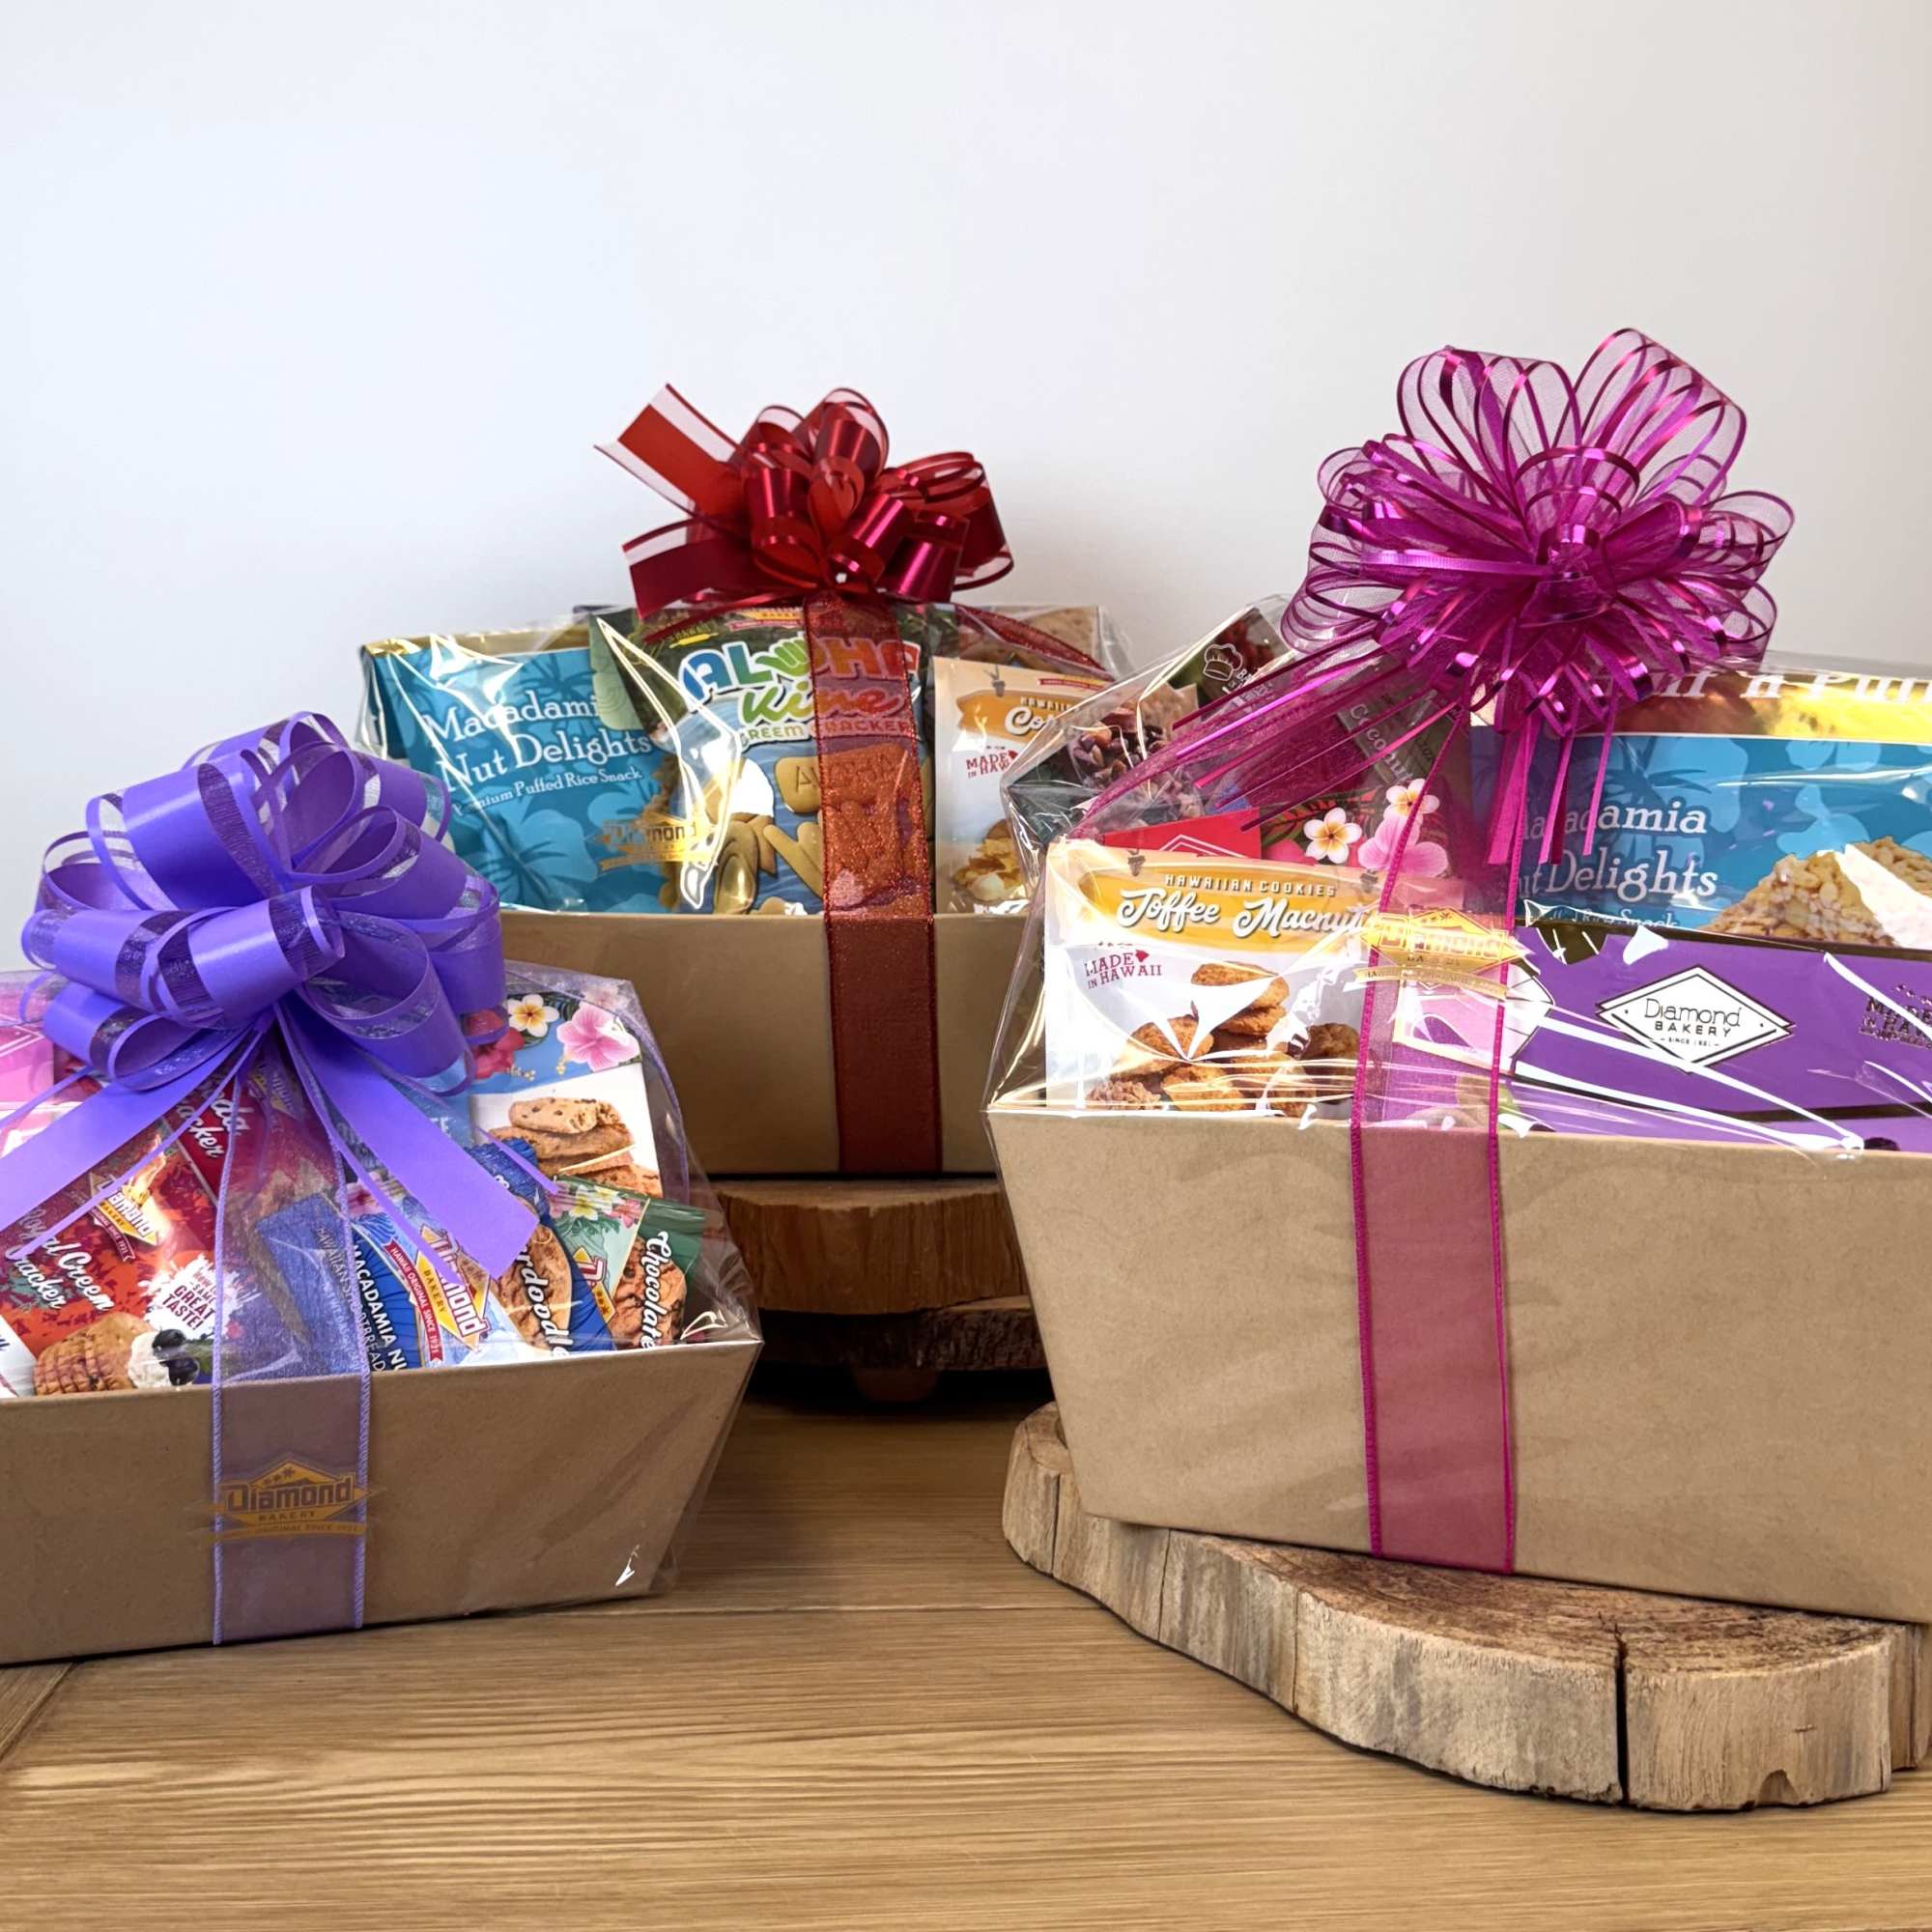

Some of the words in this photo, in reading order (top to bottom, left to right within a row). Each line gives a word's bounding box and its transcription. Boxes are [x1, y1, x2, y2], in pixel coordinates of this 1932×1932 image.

[423, 690, 598, 748] Macadami
[1020, 696, 1078, 713] HAWAII
[437, 749, 508, 793] Nut
[509, 728, 653, 770] Delights
[966, 752, 1007, 771] MADE
[980, 758, 1010, 776] HAW
[514, 780, 565, 799] Puffed
[566, 772, 598, 789] Rice
[600, 766, 643, 783] Snack
[1165, 873, 1254, 893] HAWAIIAN
[1259, 880, 1338, 897] COOKIES
[1546, 846, 1719, 902] Delights
[1116, 887, 1222, 933] Toffee
[1084, 952, 1135, 978] MADE
[1087, 978, 1098, 990] IN
[1100, 964, 1163, 985] HAWAII
[1643, 997, 1743, 1028] Diamond
[1655, 1020, 1732, 1037] BAKERY
[1668, 1037, 1690, 1045] SINCE
[58, 1251, 115, 1311] Creem
[423, 1268, 447, 1313] BAKERY
[639, 1230, 672, 1349] Chocolate
[162, 1293, 205, 1331] TASTE!
[173, 1285, 217, 1321] GREAT
[353, 1245, 397, 1349] MACADAMIA
[387, 1348, 408, 1371] NU
[389, 1246, 411, 1273] HAWAII
[408, 1271, 429, 1309] ORIGINAL
[422, 1308, 435, 1332] SINCE
[429, 1333, 440, 1354] 1921
[220, 1476, 354, 1512] Diamond
[258, 1510, 316, 1522] BAKERY
